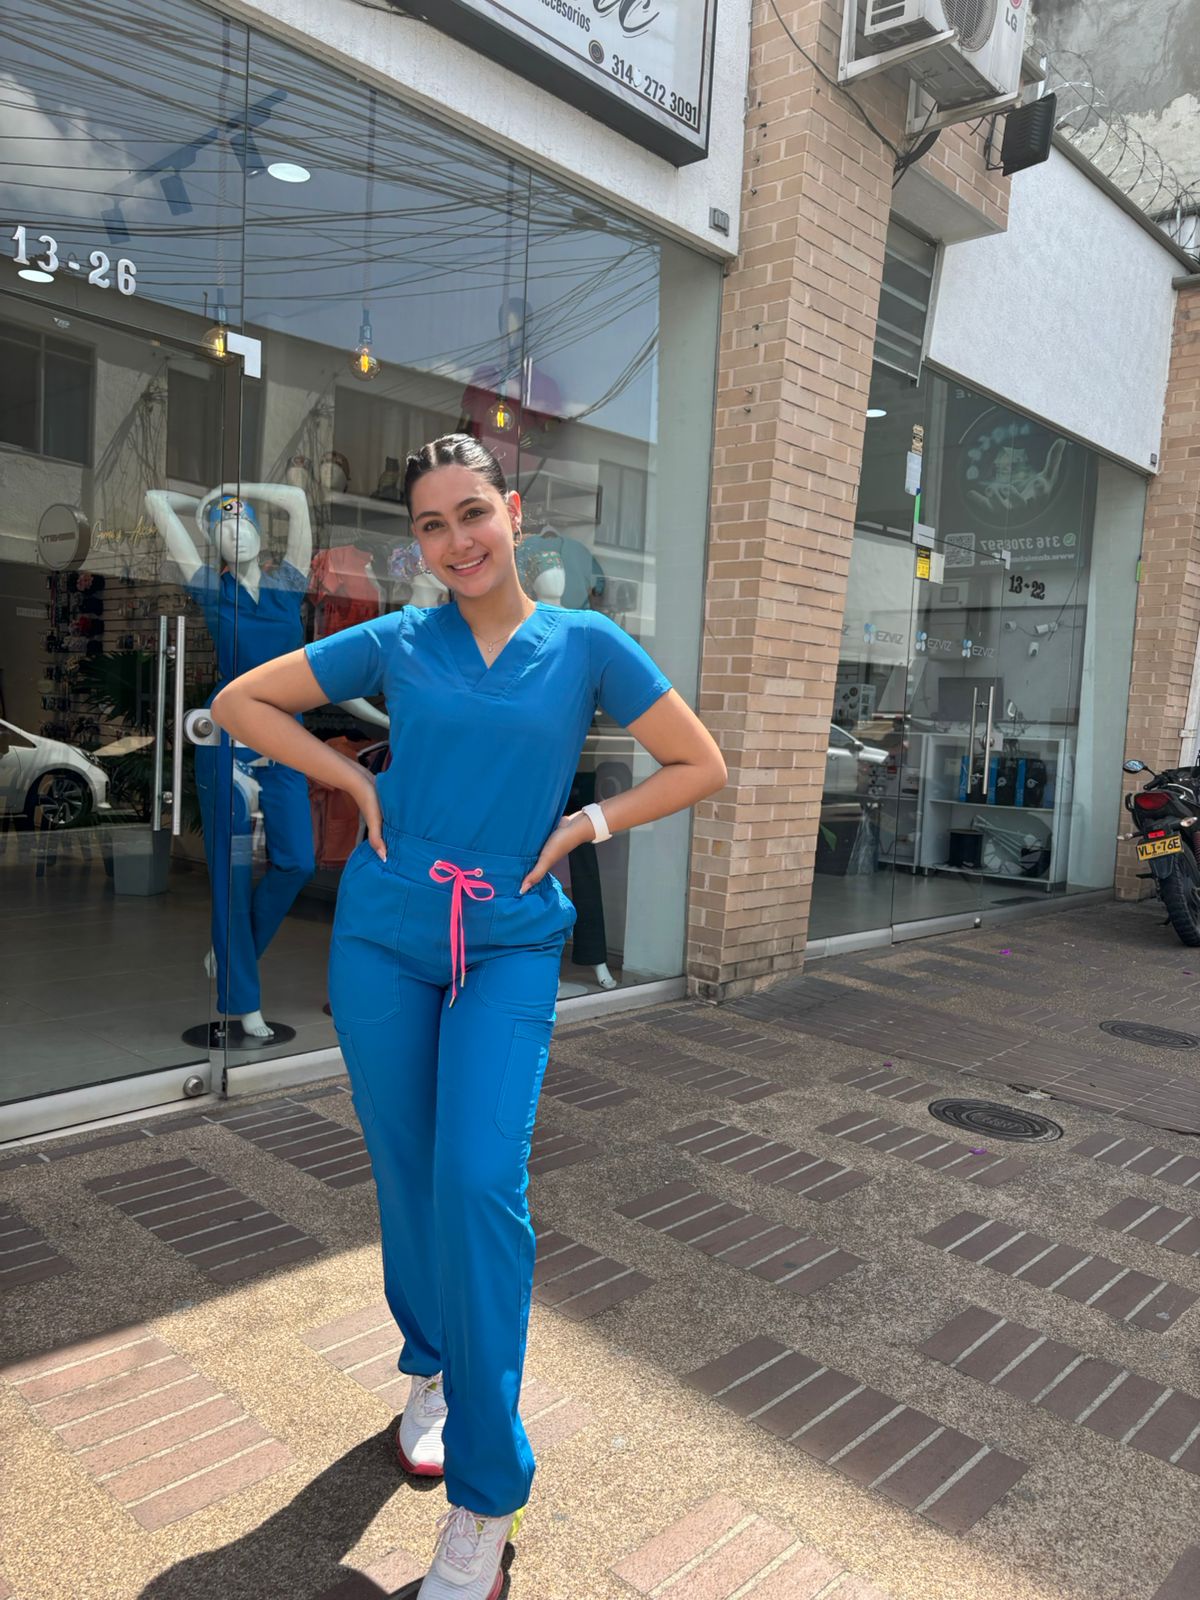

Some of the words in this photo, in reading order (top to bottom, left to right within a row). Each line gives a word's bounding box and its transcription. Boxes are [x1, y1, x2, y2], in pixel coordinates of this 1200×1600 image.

[538, 0, 591, 32] cesorios
[1005, 7, 1018, 32] LG
[611, 54, 634, 84] 314
[644, 75, 666, 106] 272
[670, 92, 697, 125] 3091
[12, 225, 137, 296] 13-26
[1008, 574, 1046, 600] 13-22
